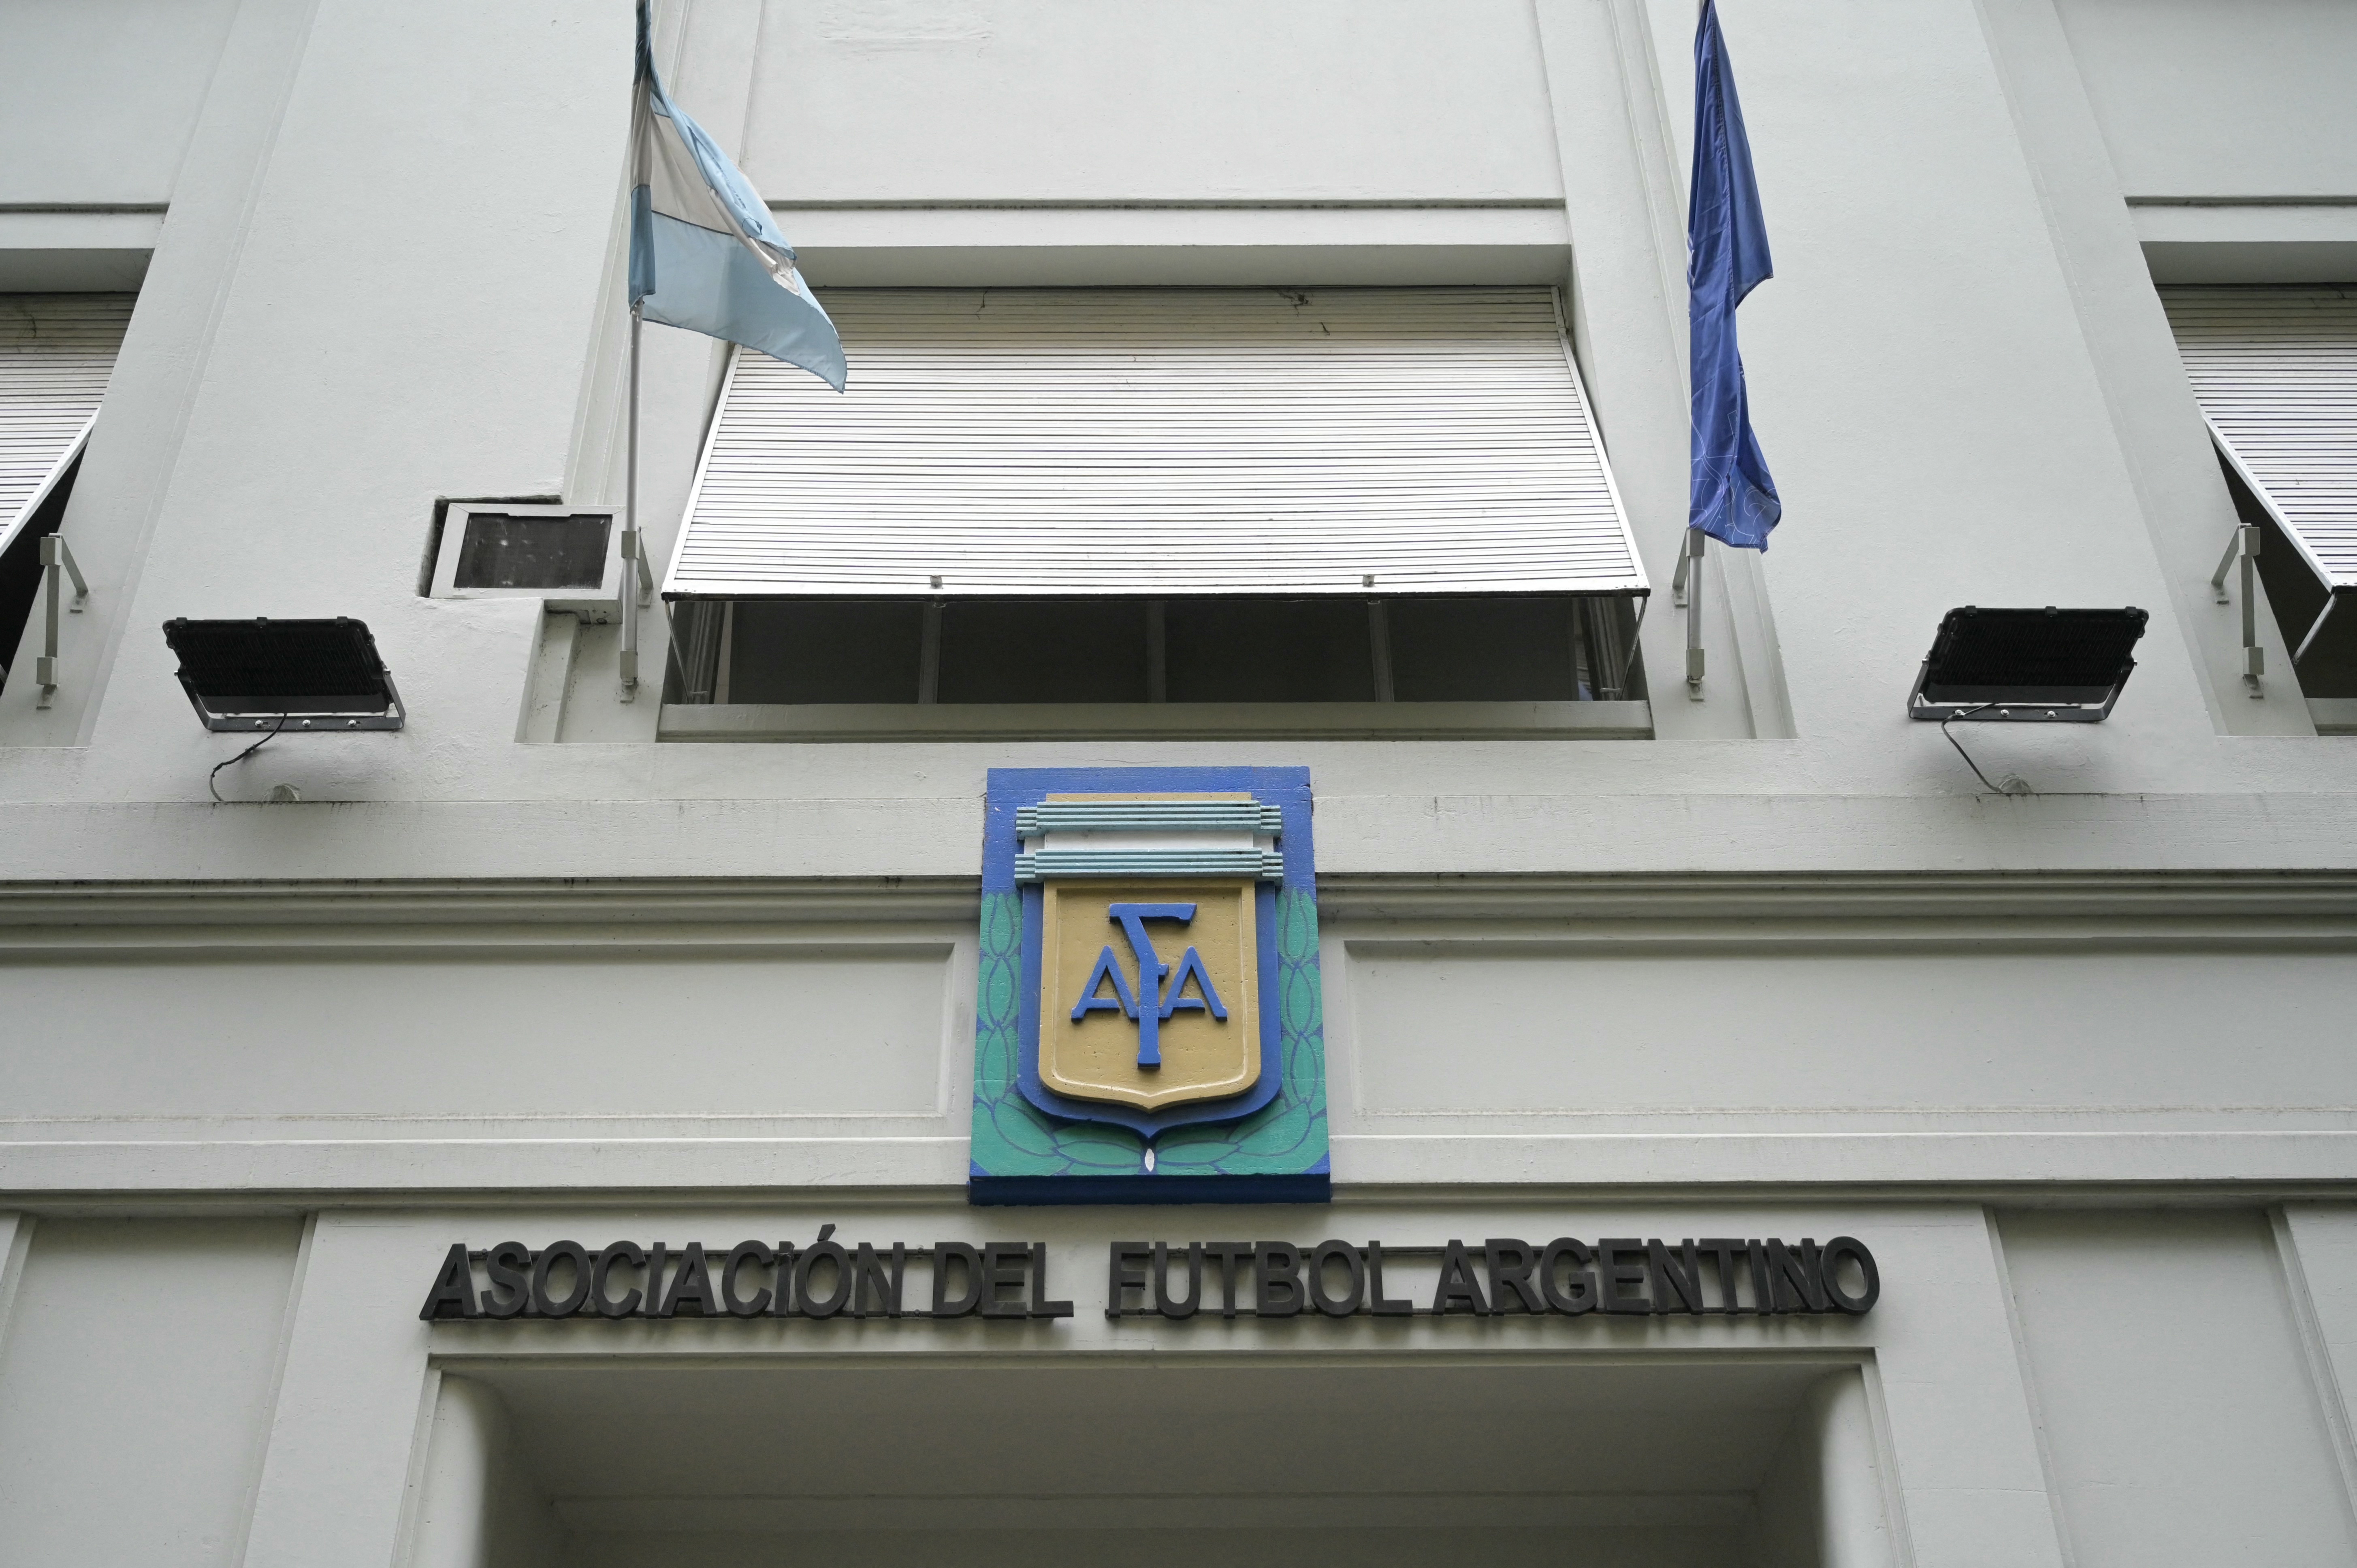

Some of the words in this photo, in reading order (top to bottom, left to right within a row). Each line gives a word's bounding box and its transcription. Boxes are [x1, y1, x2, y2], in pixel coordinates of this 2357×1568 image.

[1071, 903, 1228, 1068] AFA
[419, 1223, 905, 1320] ASOCIACIÓN
[931, 1242, 1073, 1319] DEL
[1105, 1239, 1413, 1320] FUTBOL
[1431, 1236, 1880, 1316] ARGENTINO
